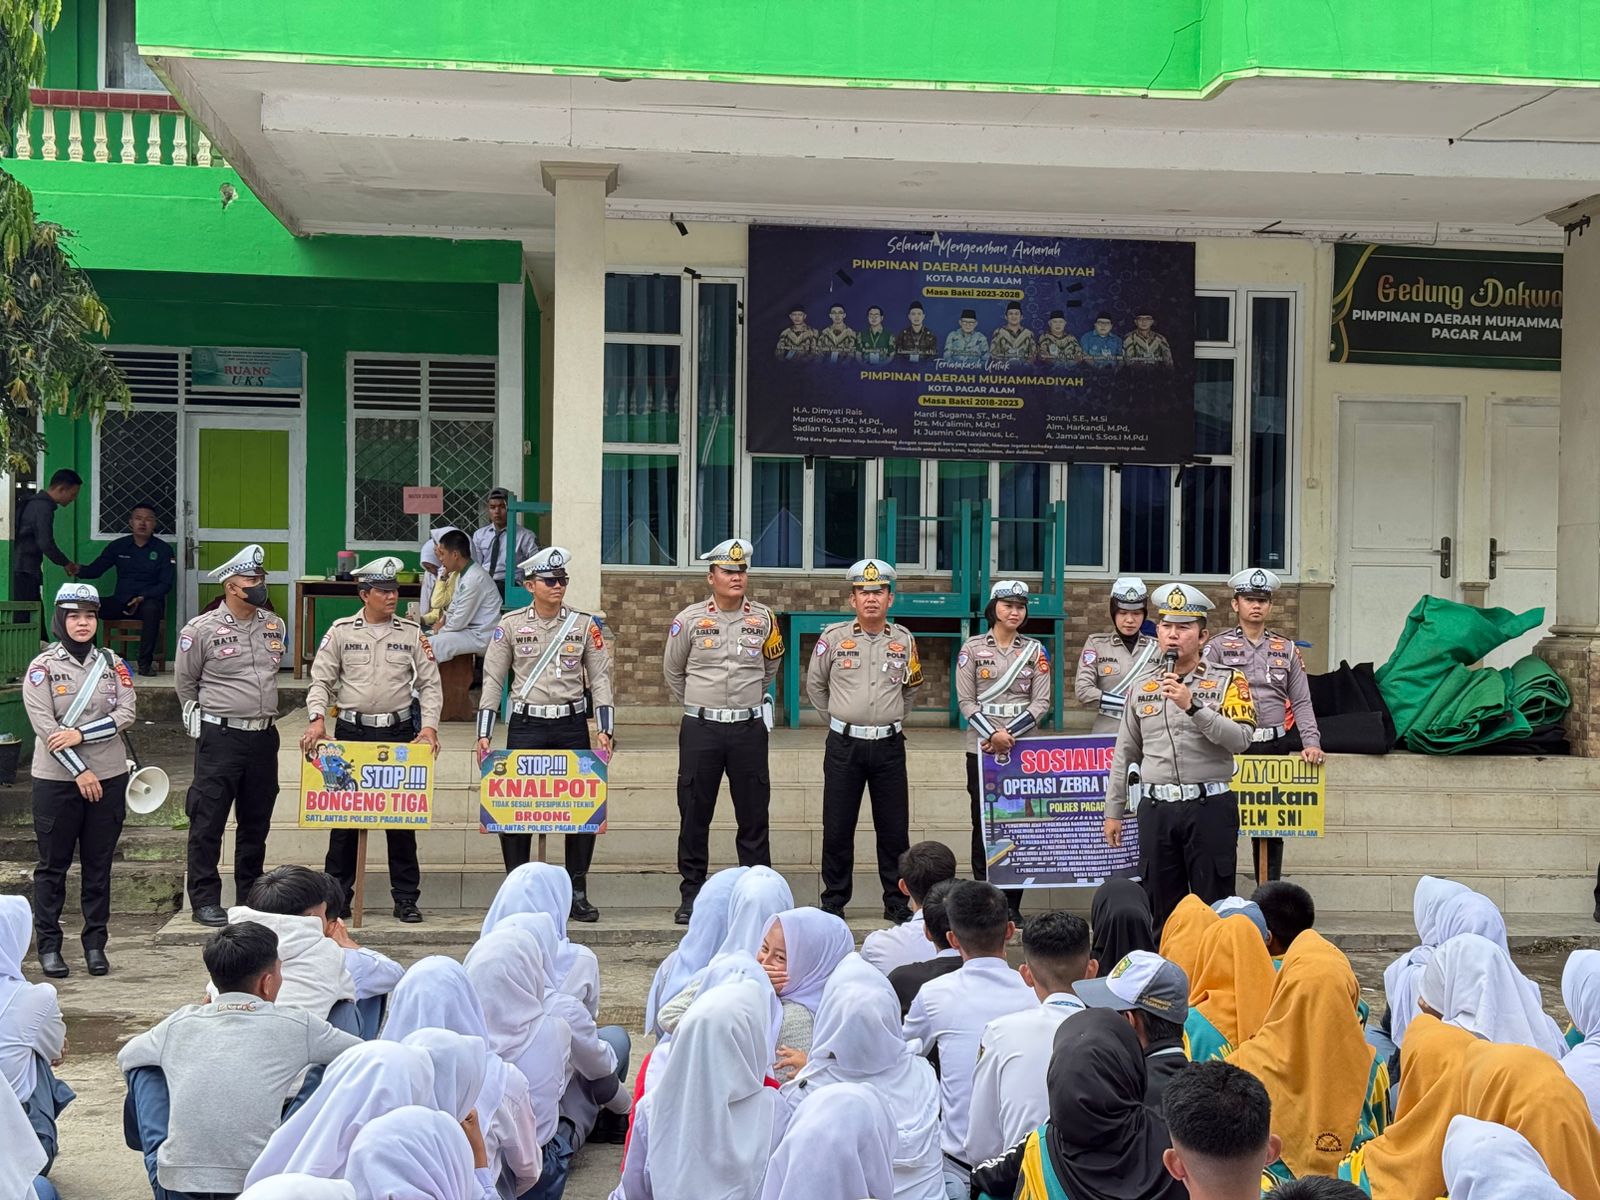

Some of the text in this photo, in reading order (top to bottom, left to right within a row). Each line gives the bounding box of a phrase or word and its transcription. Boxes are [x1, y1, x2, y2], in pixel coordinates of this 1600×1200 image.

[887, 236, 1061, 259] Selamat Mengemban Amanah
[852, 259, 1095, 277] PIMPINAN DAERAH MUHAMMADIYAH
[926, 274, 1022, 285] KOTA PAGAR ALAM
[951, 288, 973, 297] Bakti
[976, 290, 1020, 298] 2023-2028
[1377, 275, 1464, 309] Gedung
[1352, 309, 1562, 329] PIMPINAN DAERAH MUHAMMA
[1432, 328, 1522, 342] PAGAR ALAM
[224, 366, 271, 375] RUANG
[860, 371, 1084, 386] PIMPINAN DAERAH MUHAMMADIYAH
[928, 384, 953, 392] KOTA
[955, 385, 986, 394] PAGAR
[949, 397, 972, 405] Bakti
[975, 398, 1019, 406] 2018-2023
[793, 416, 833, 424] Mardiono,
[1046, 414, 1070, 423] Jonni,
[955, 430, 1003, 438] Oktavianus,
[488, 779, 600, 798] KNALPOT
[1003, 778, 1056, 795] OPERASI
[1059, 776, 1099, 793] ZEBRA
[306, 791, 428, 812] BONCENG TIGA
[1233, 786, 1318, 805] nakan
[1050, 802, 1078, 813] POLRES
[515, 811, 571, 822] BROONG
[1278, 810, 1301, 826] SNI
